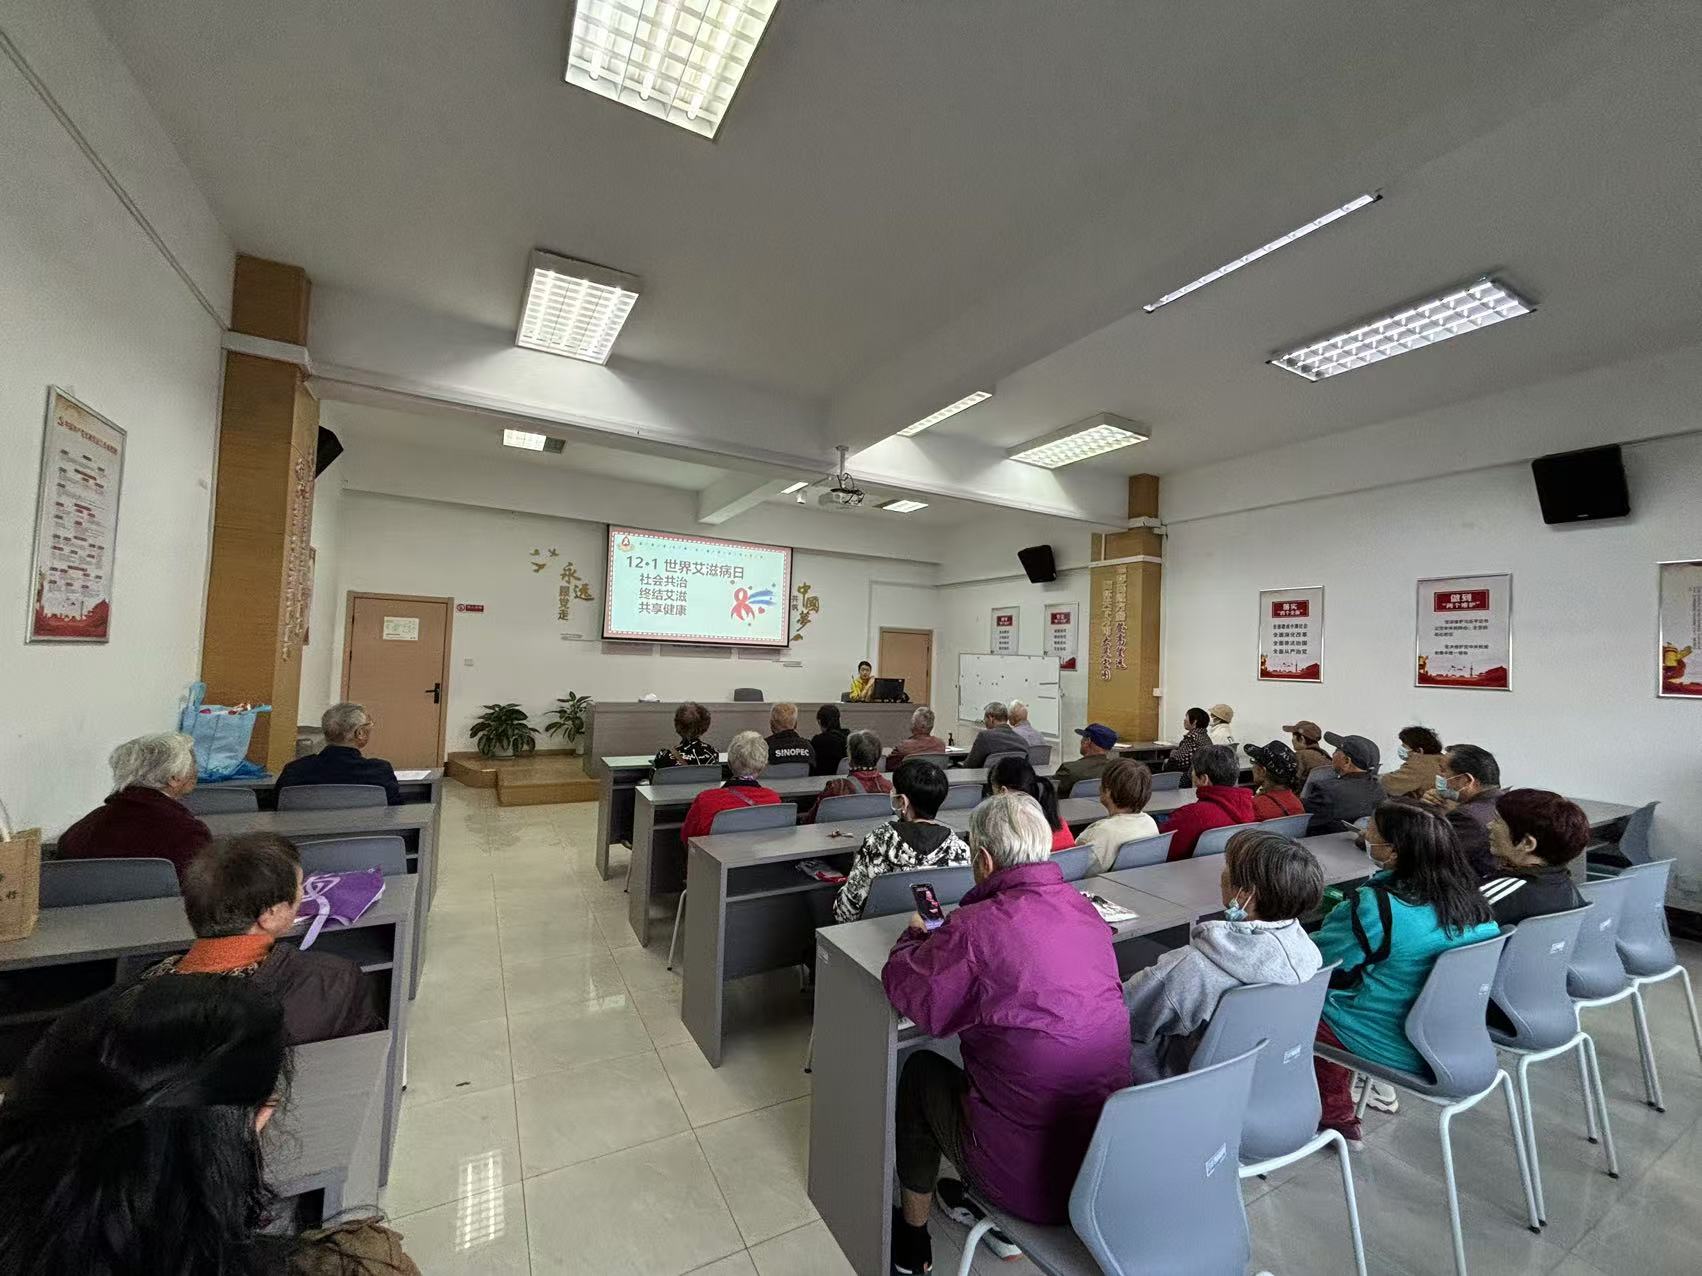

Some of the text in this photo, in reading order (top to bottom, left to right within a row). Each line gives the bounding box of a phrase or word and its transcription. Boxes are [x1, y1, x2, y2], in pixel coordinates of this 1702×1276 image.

[664, 558, 744, 579] 世界艾滋病日
[639, 573, 688, 588] 社会共治
[639, 588, 688, 602] 终结艾滋
[638, 602, 687, 616] 共享健康
[775, 748, 810, 757] SINOPEC
